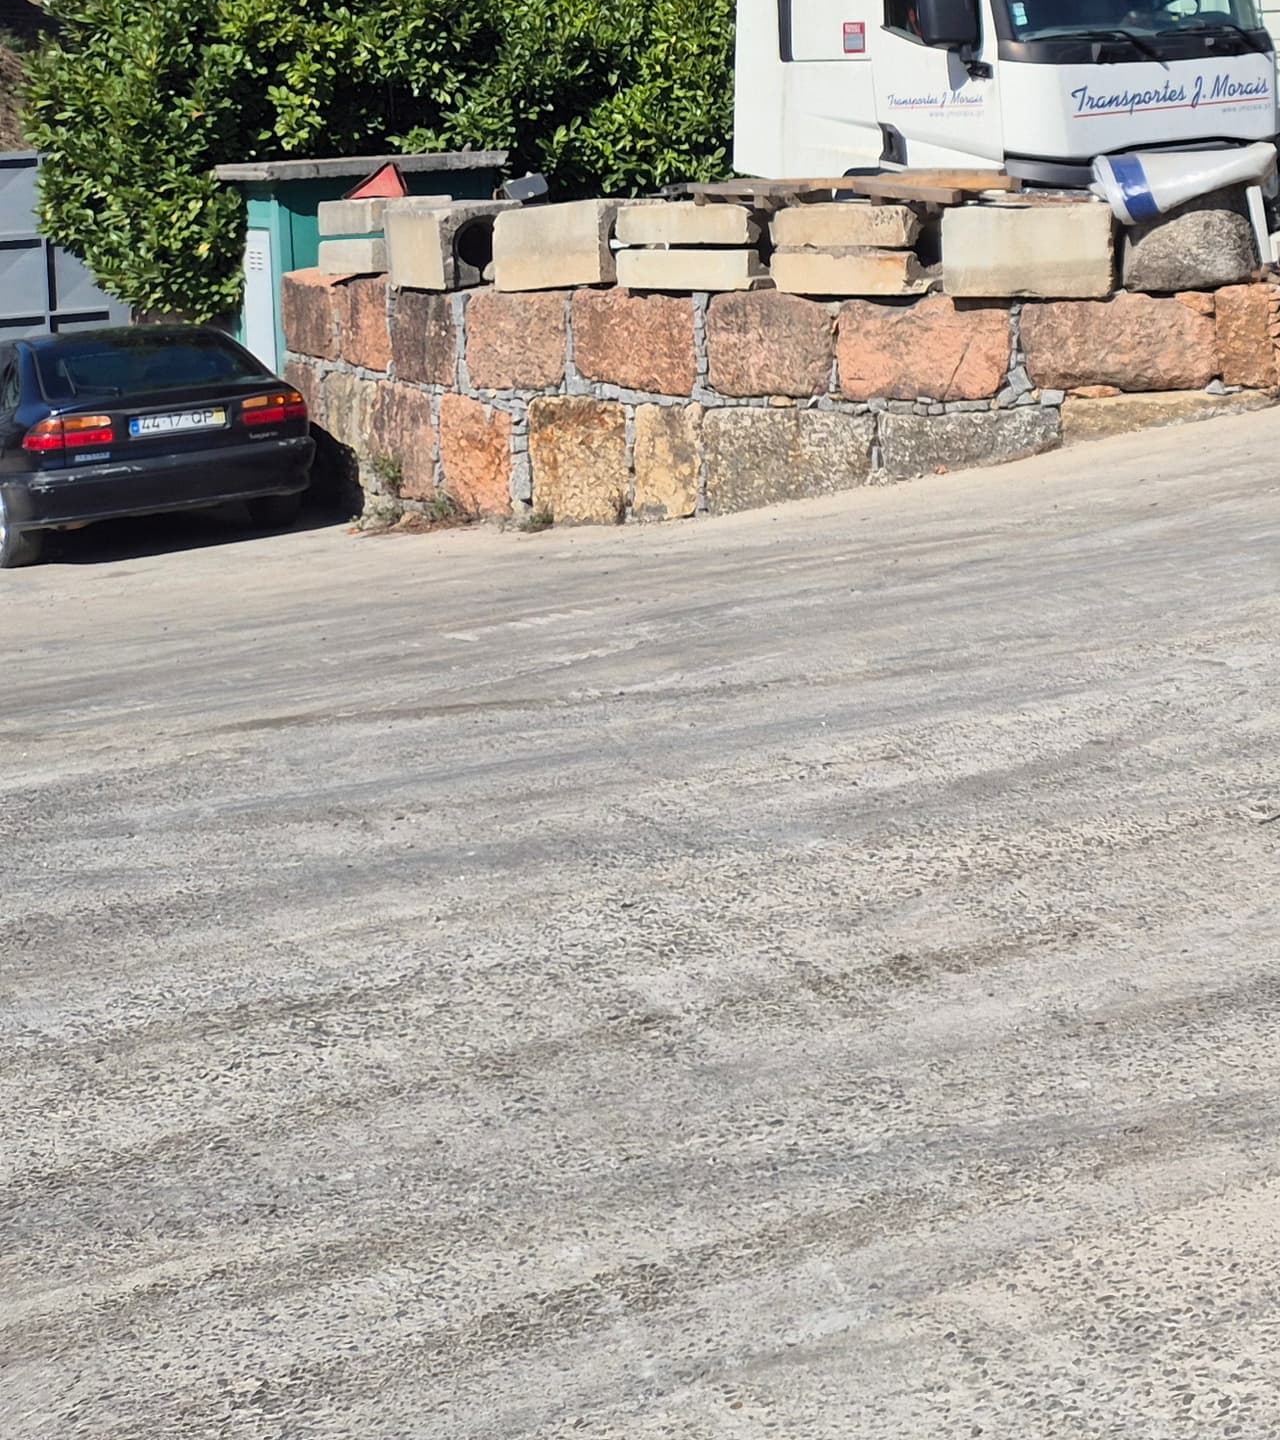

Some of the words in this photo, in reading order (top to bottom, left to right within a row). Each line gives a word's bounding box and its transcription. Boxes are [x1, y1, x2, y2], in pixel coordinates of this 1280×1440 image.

[887, 93, 938, 109] Transportes
[1071, 80, 1187, 115] Transportes
[1209, 74, 1270, 100] Morais
